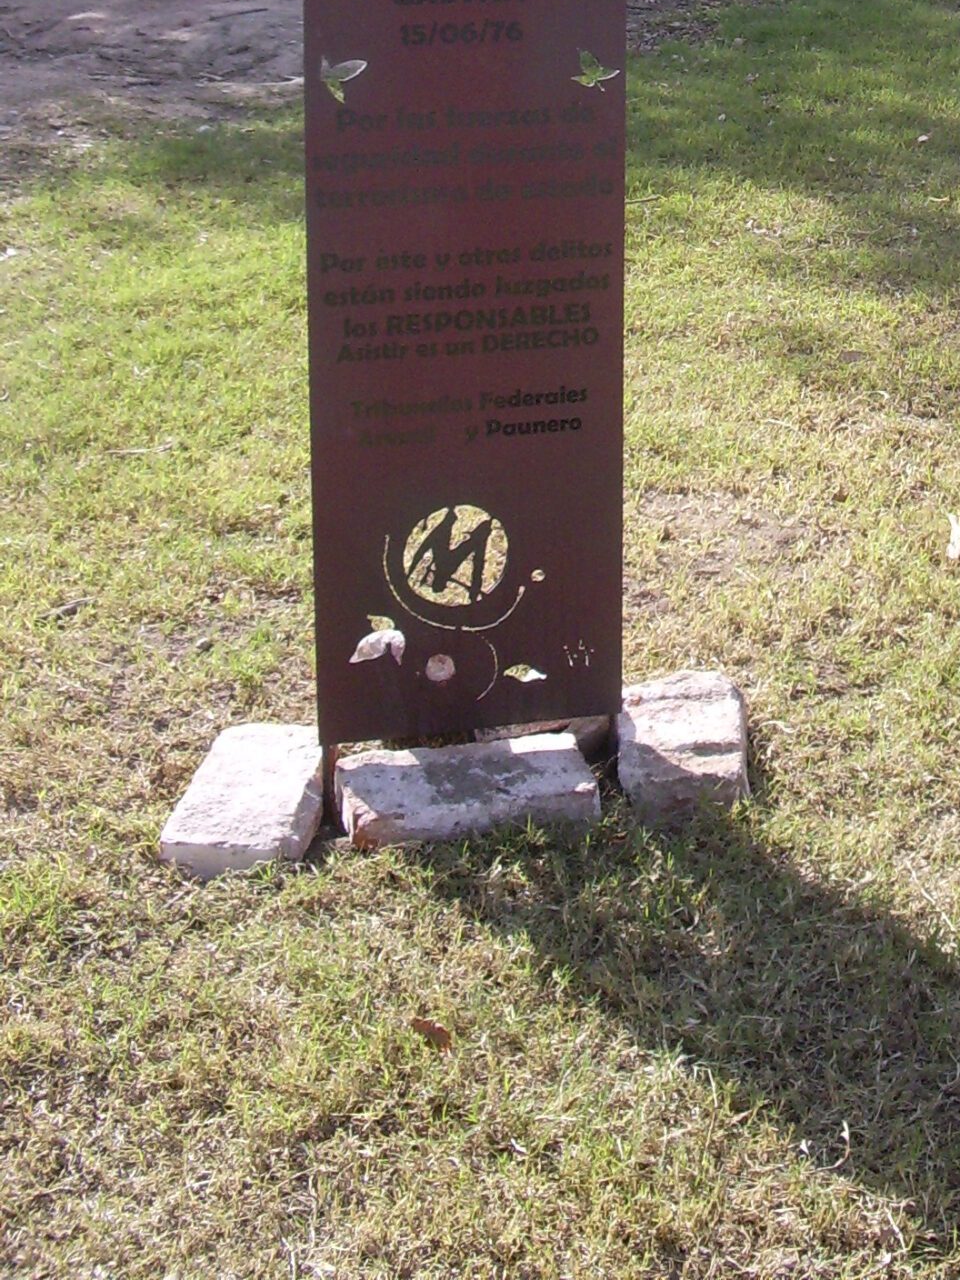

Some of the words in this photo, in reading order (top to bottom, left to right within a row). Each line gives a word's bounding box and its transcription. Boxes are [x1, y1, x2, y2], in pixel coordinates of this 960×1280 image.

[400, 19, 523, 46] 15/06/76
[336, 108, 388, 132] Por
[396, 106, 436, 129] las
[561, 102, 594, 124] de
[476, 178, 510, 202] de
[320, 251, 367, 273] Por
[436, 253, 450, 272] y
[459, 246, 521, 267] otros
[530, 239, 612, 262] delitos
[323, 283, 394, 307] están
[405, 278, 485, 302] siendo
[344, 318, 377, 338] los
[386, 303, 591, 336] RESPONSABLES
[336, 342, 409, 364] Asistir
[416, 341, 437, 358] es
[445, 339, 474, 356] un
[482, 327, 599, 353] DERECHO
[480, 385, 588, 411] Federales
[465, 426, 478, 446] y
[485, 416, 582, 438] Paunero
